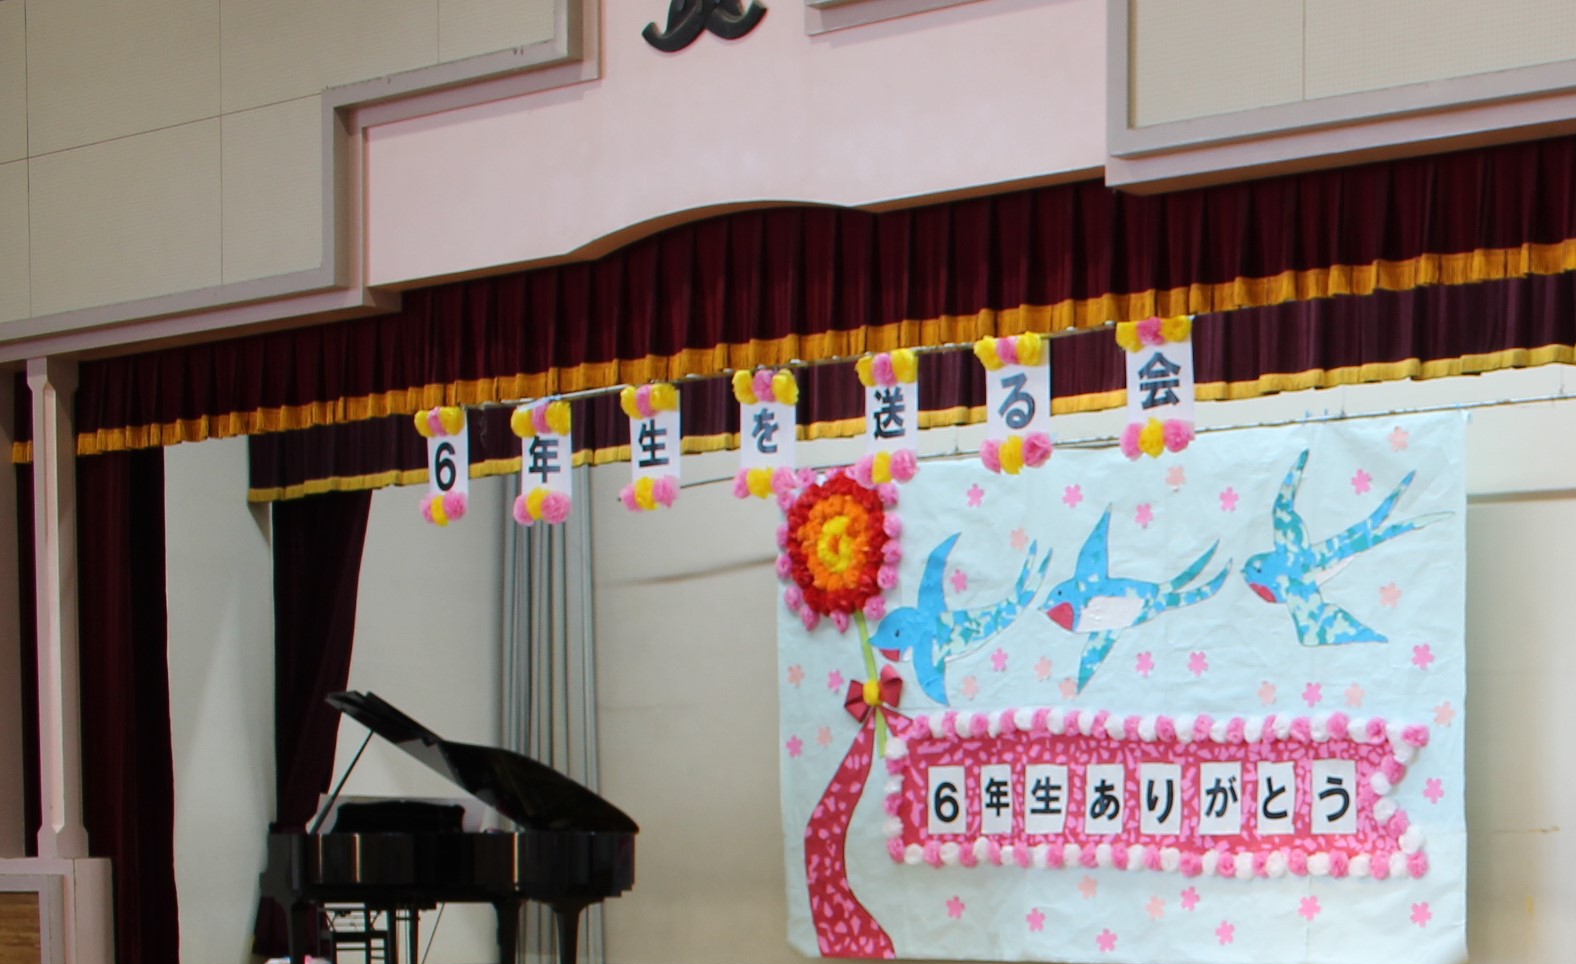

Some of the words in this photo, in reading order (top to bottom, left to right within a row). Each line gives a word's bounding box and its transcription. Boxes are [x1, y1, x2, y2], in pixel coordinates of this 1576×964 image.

[433, 351, 1182, 493] 6年生を送る会
[932, 777, 1353, 823] 6年生ありがとう
